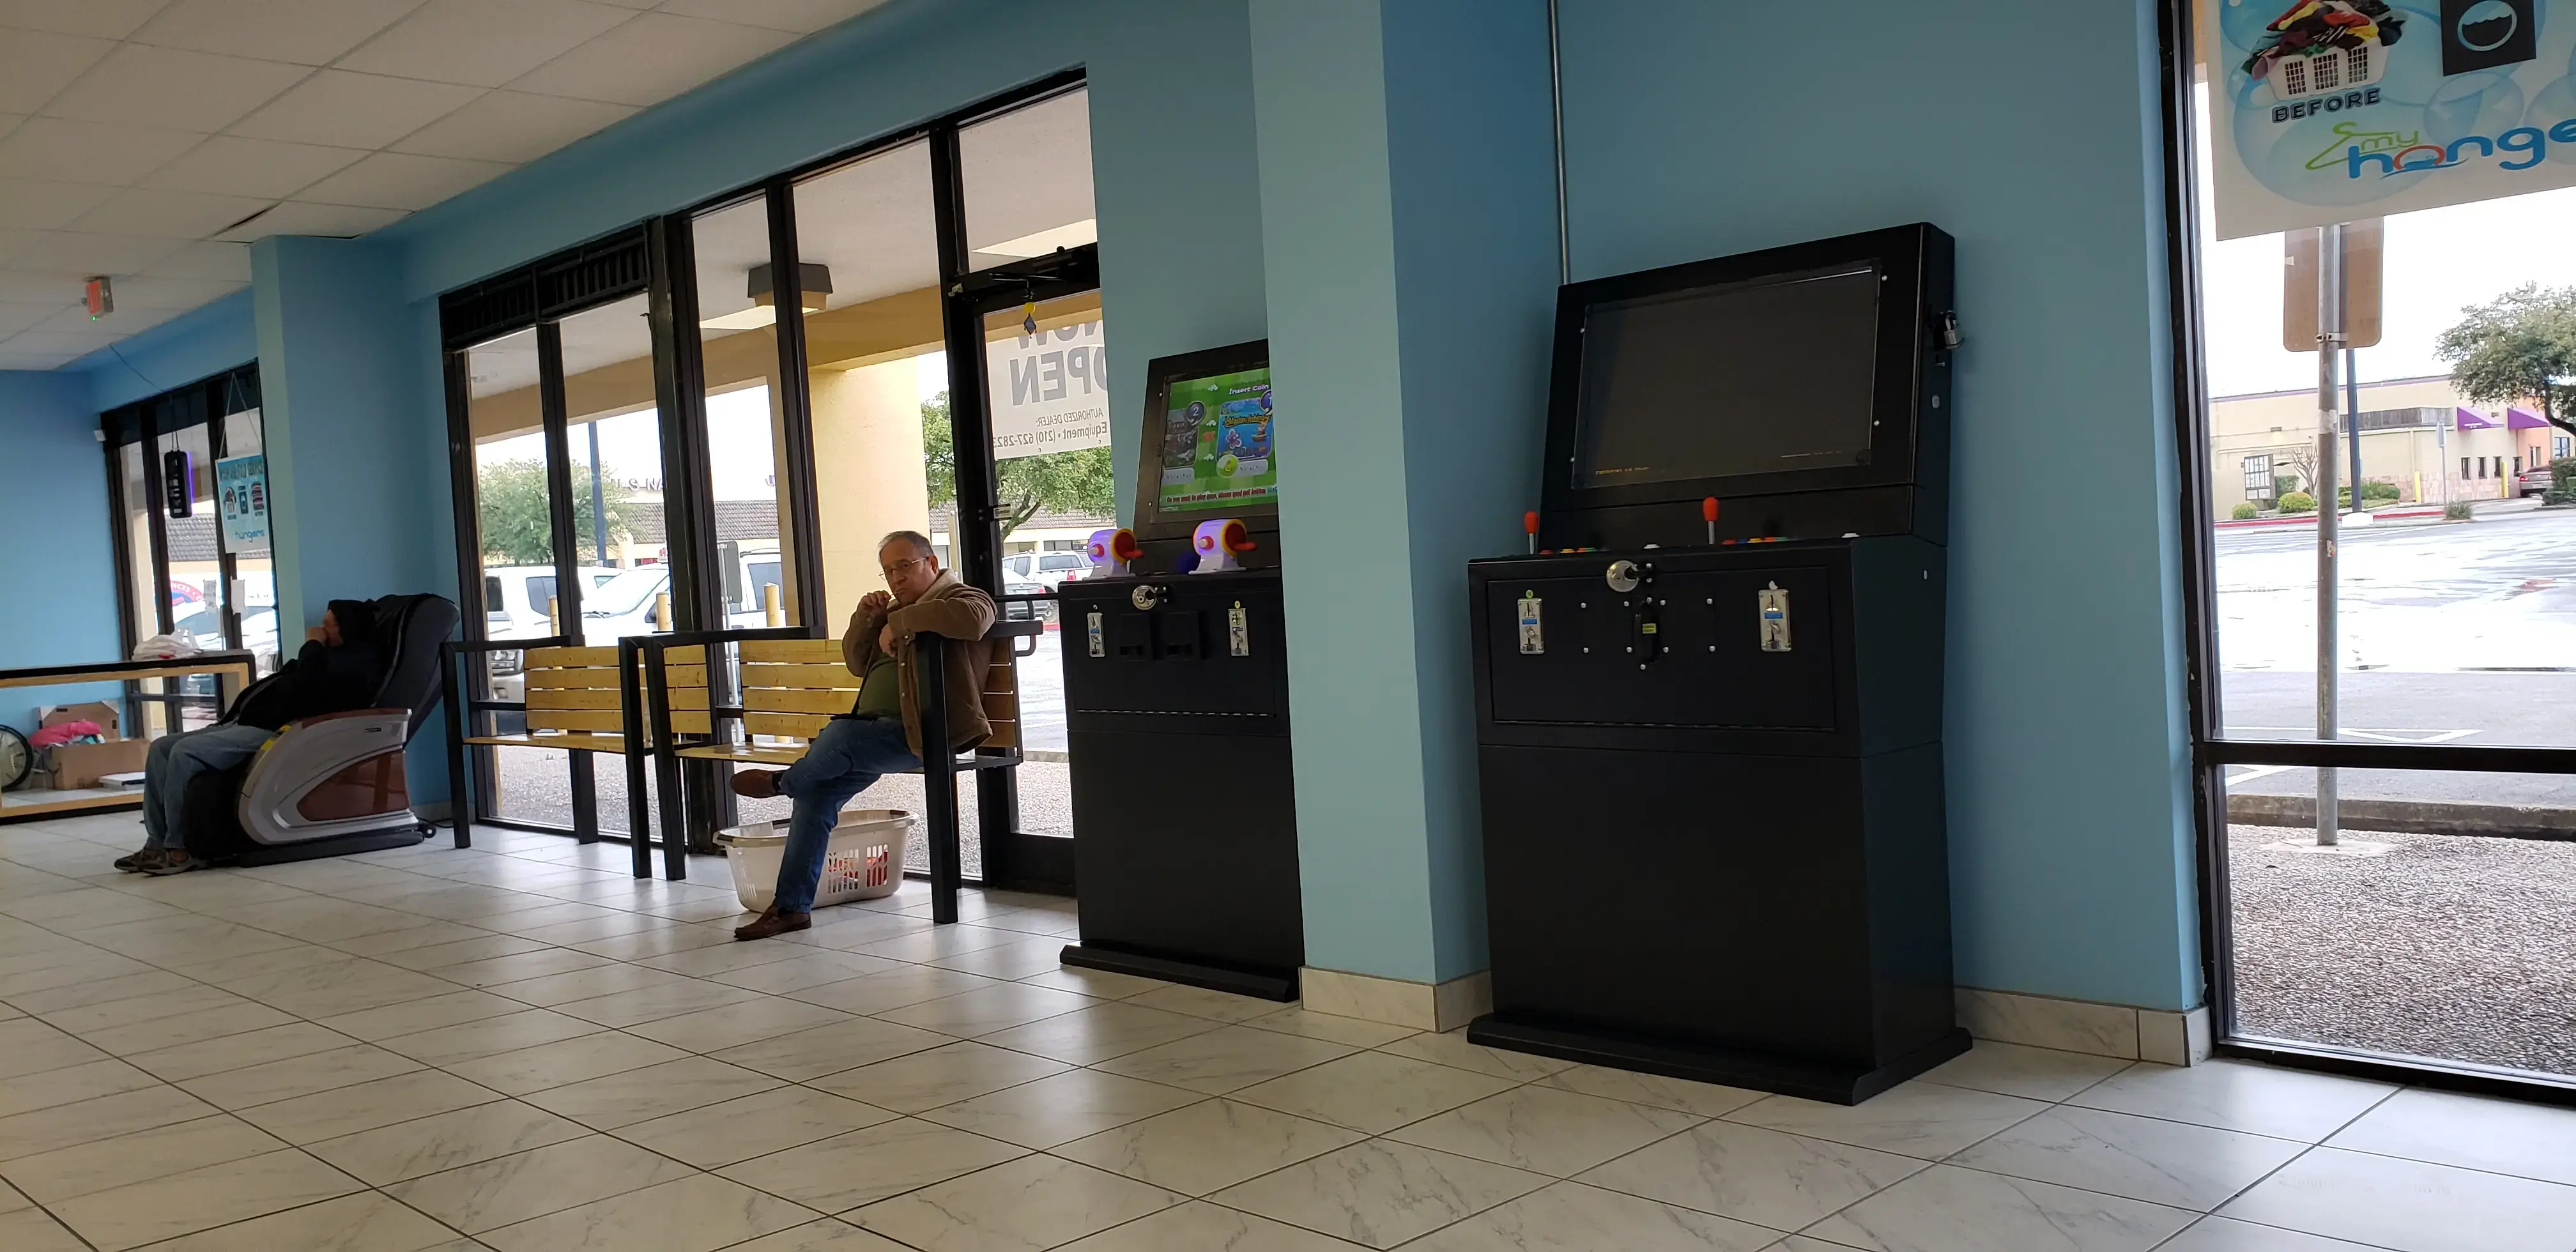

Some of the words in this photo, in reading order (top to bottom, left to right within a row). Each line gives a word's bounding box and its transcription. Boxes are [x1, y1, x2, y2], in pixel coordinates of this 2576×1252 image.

[2272, 88, 2381, 124] BEFORE
[2359, 130, 2419, 151] my
[1229, 386, 1252, 395] Insert
[1193, 407, 1199, 416] 2
